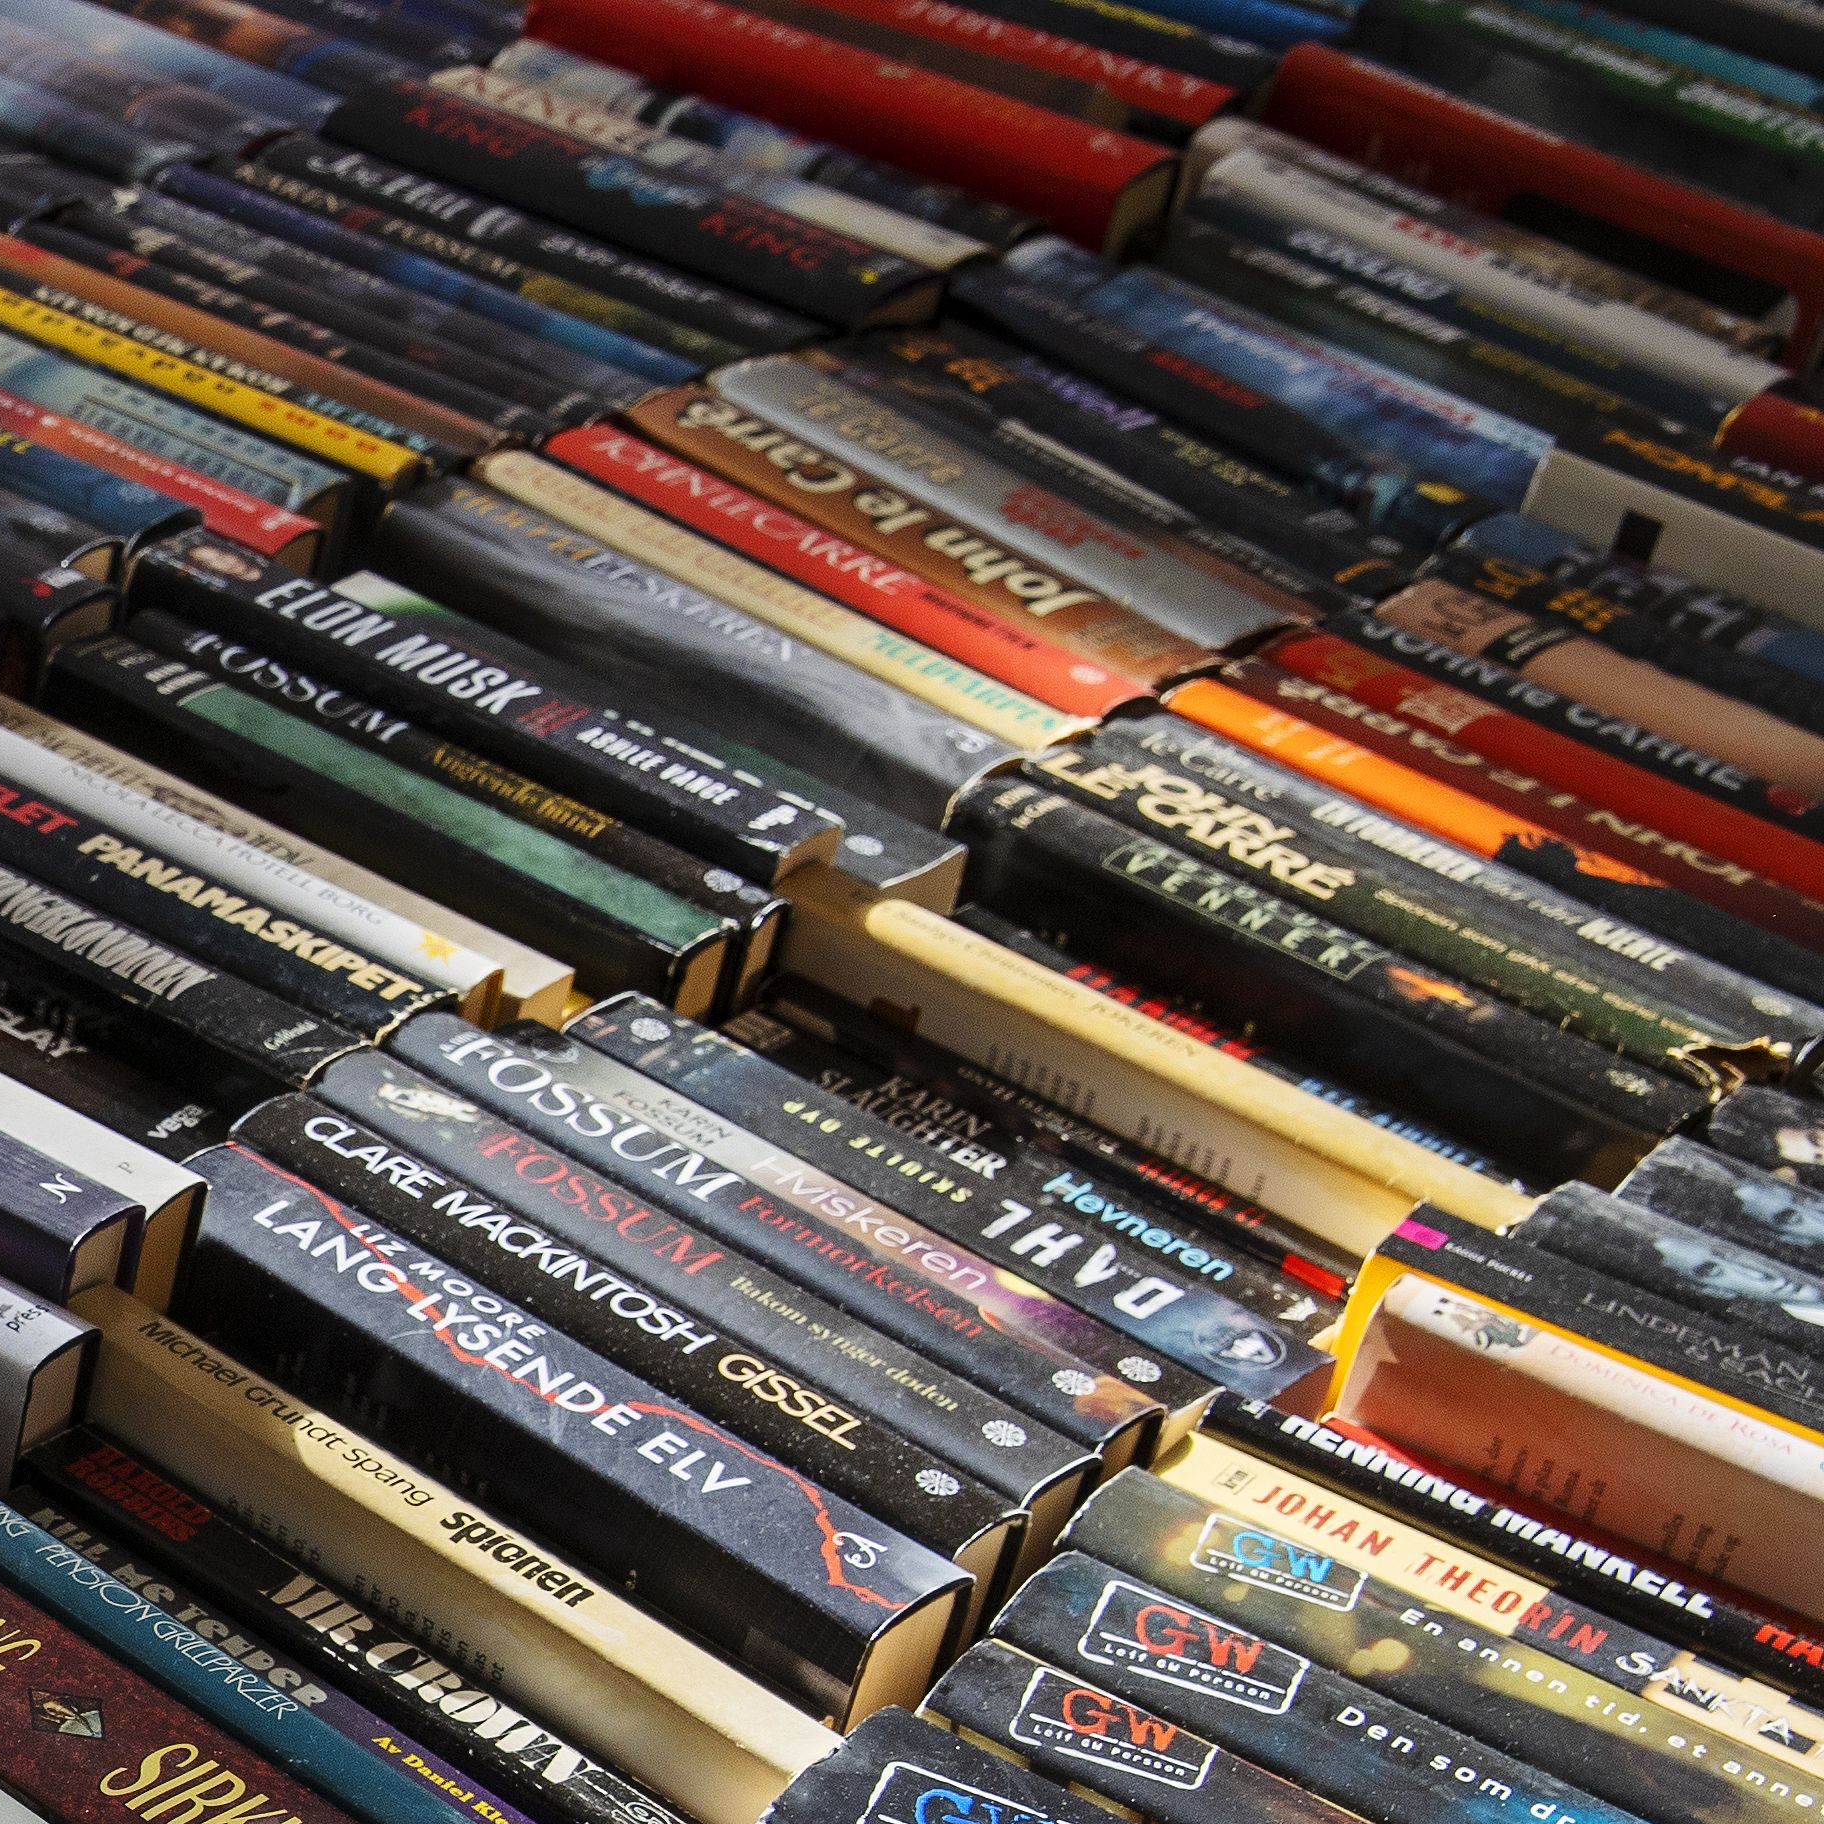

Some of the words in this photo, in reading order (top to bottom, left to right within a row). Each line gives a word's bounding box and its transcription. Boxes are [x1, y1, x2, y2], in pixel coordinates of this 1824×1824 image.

[255, 577, 379, 650] ELON
[372, 632, 544, 721] MUSK
[75, 831, 444, 1002] PANAMASKIPET
[439, 1030, 745, 1204] FOSSUM
[481, 1127, 726, 1278] FOSSUM
[305, 1114, 447, 1198] CLARE
[432, 1173, 720, 1355] MACKINTOSH
[716, 1349, 858, 1452] GISSEL
[748, 1153, 986, 1293] Hviskeren
[1042, 1170, 1235, 1285] Hevneren
[252, 1195, 404, 1298] LANG
[405, 1284, 648, 1437] LYSENDE
[634, 1420, 754, 1499] ELV
[35, 1539, 159, 1623] PENSION
[152, 1616, 301, 1723] GRILLPARZER
[439, 1507, 598, 1610] spionen
[1253, 1483, 1394, 1559] JOHAN
[1412, 1549, 1609, 1657] THEORIN
